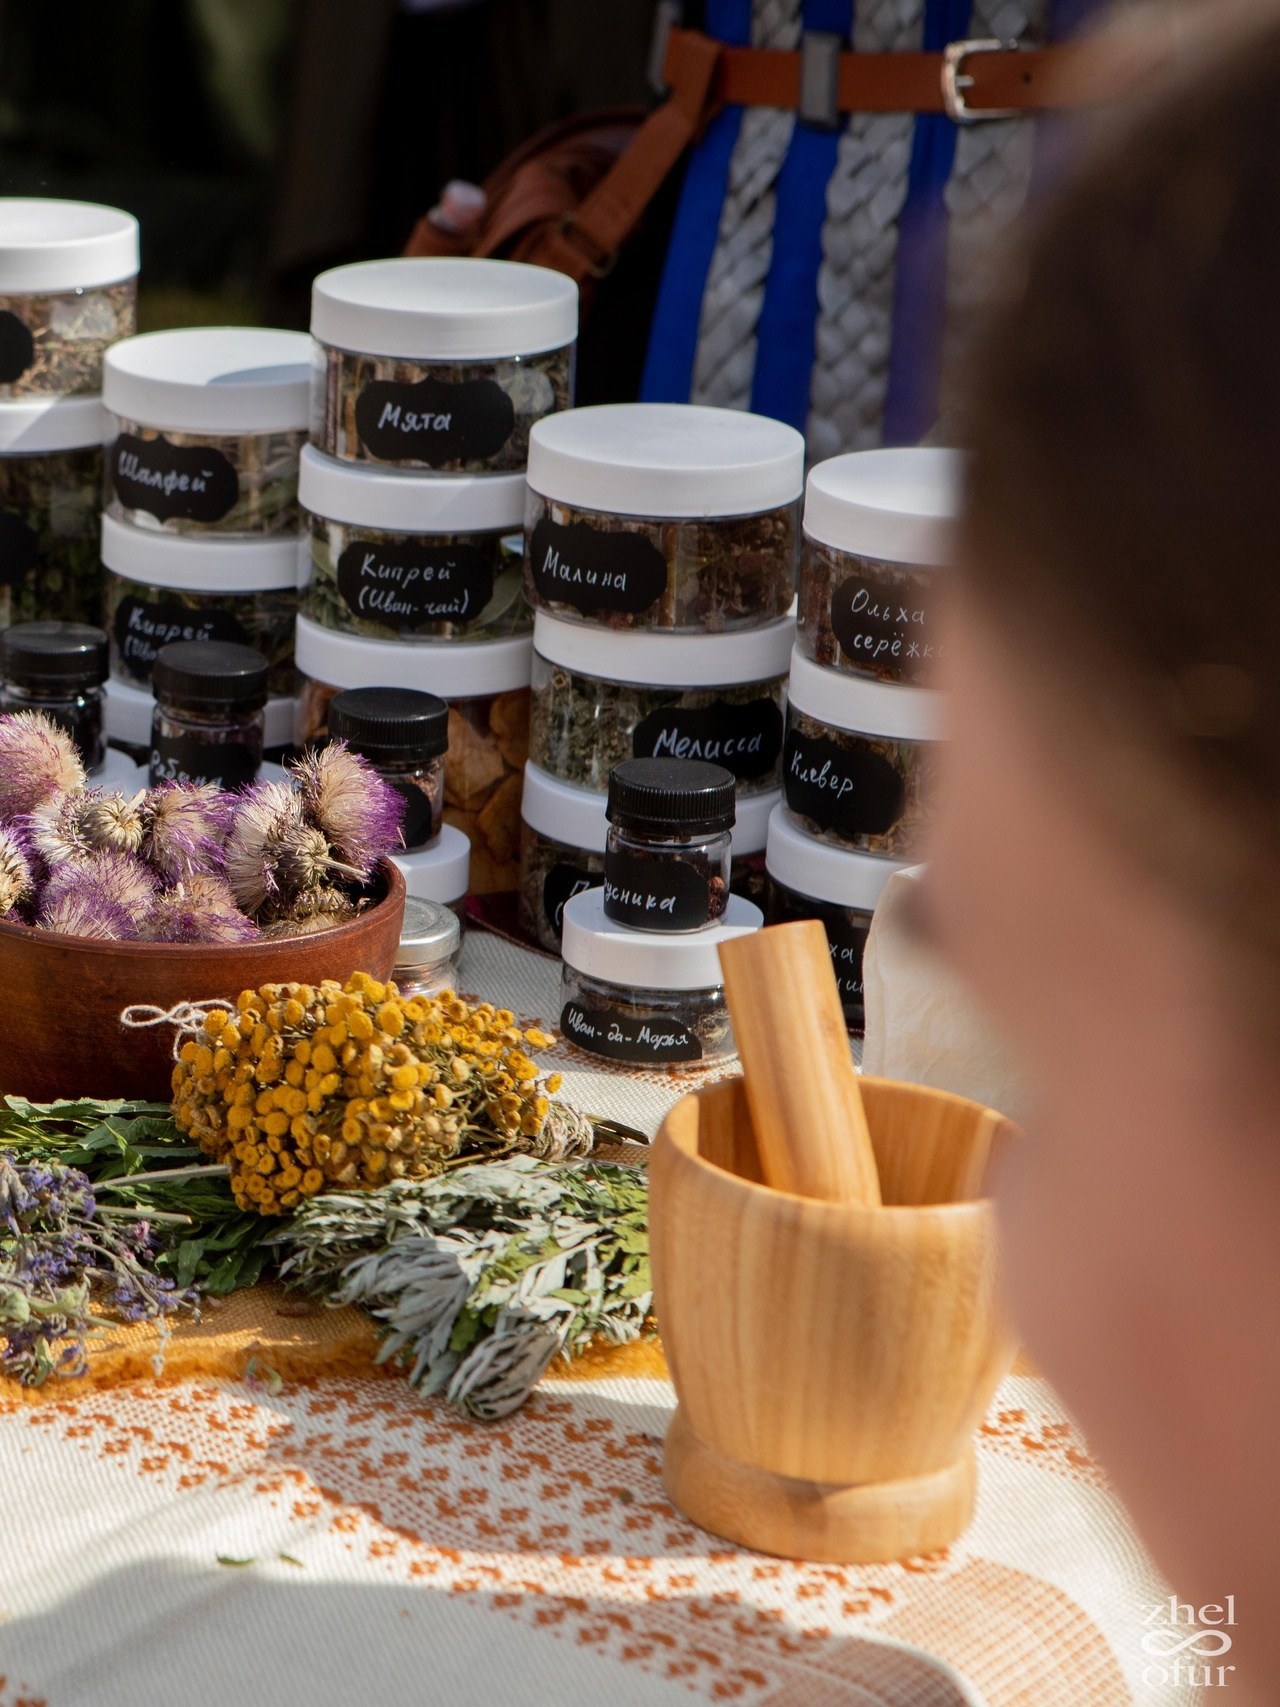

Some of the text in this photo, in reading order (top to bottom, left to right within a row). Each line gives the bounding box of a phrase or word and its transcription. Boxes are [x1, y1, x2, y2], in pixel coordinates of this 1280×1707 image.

[377, 402, 452, 433] Мята
[118, 450, 213, 497] Шалфей
[360, 552, 457, 589] Кипрей
[542, 545, 627, 592] Малина
[128, 606, 214, 642] Кипрей
[851, 588, 925, 625] Ольха
[653, 727, 763, 759] Мелисса
[791, 750, 854, 799] Клевер
